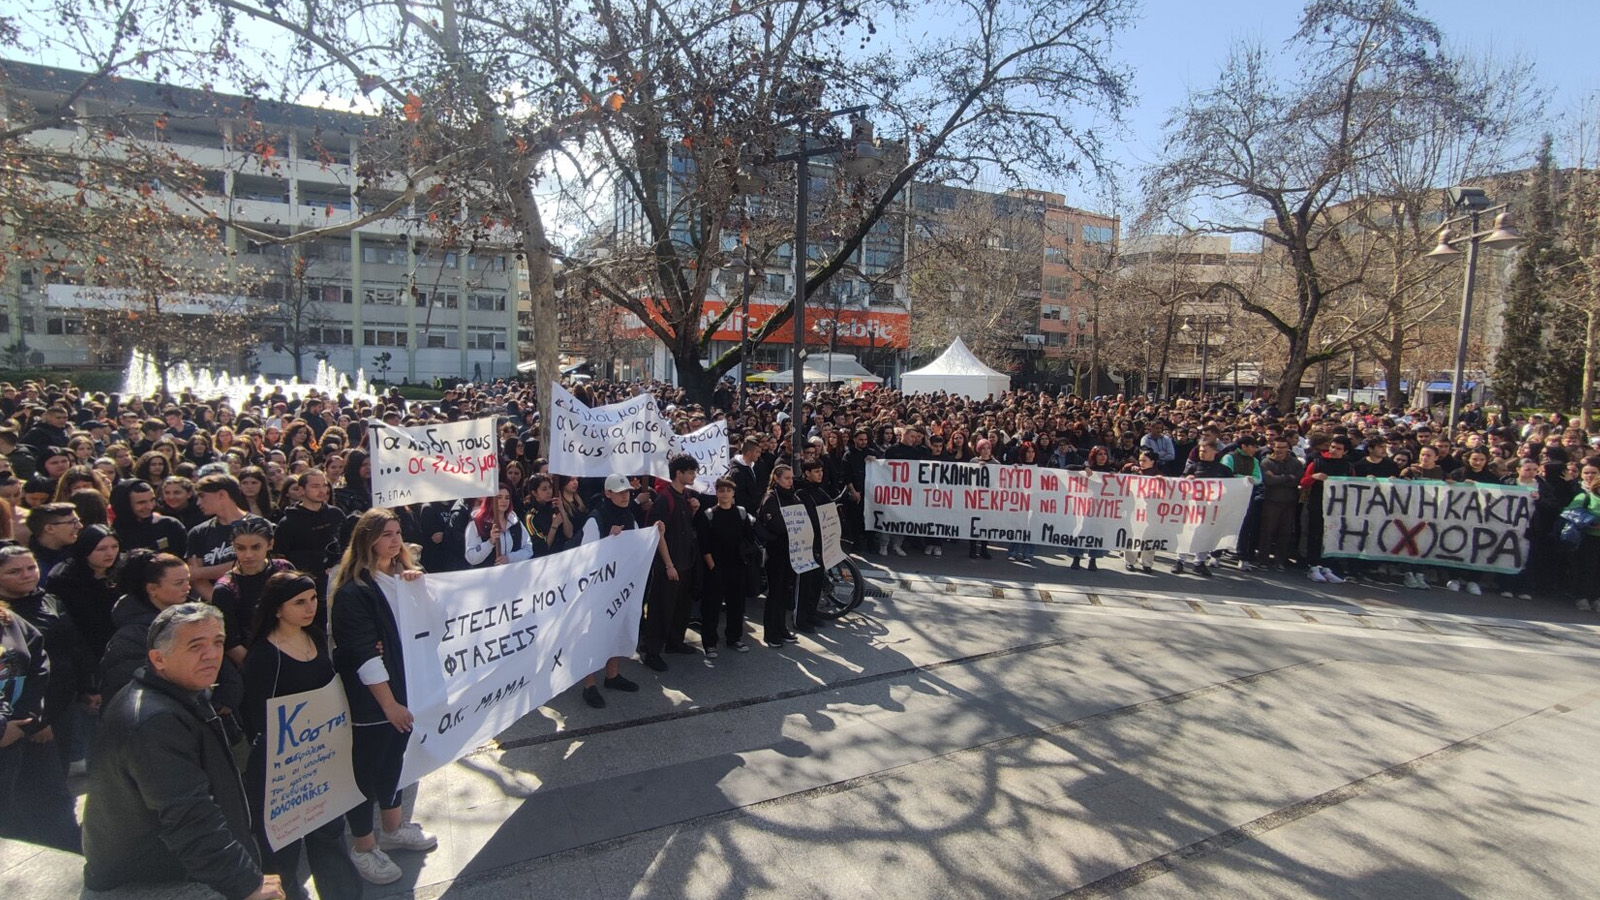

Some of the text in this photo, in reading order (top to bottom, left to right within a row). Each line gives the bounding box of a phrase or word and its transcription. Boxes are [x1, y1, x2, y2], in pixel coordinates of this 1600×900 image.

[819, 317, 893, 341] Public
[369, 424, 400, 450] Τα
[407, 428, 454, 455] κδη
[388, 489, 412, 501] ΕΠΑΛ
[888, 461, 910, 483] ΤΟ
[918, 463, 990, 488] ΕΓΚΛΗΜΑ
[999, 467, 1032, 489] ΑΥΤΟ
[1040, 474, 1059, 492] ΝΑ
[1068, 475, 1089, 494] ΜΗ
[874, 485, 912, 507] ΟΛΩΝ
[923, 488, 953, 509] ΤΩΝ
[964, 489, 1031, 512] ΝΕΚΡΩΝ
[1040, 499, 1057, 514] ΝΑ
[1064, 495, 1124, 520] ΓΙΝΟΥΜΕ
[1326, 484, 1530, 527] ΗΤΑΝ Η ΚΑΚΙΑ
[1338, 516, 1370, 552] Η
[441, 598, 524, 642] ΣΤΕΙΛΕ
[532, 583, 568, 614] ΜΟΥ
[578, 561, 618, 592] ΟΤΑΝ
[605, 581, 636, 620] 1/3/23
[444, 625, 539, 677] ΦΤΑΣΕΙΣ
[473, 676, 531, 714] ΜΑΜΑ
[270, 781, 330, 820] ΔΟΛΟΦΟΝΙΚΕΣ
